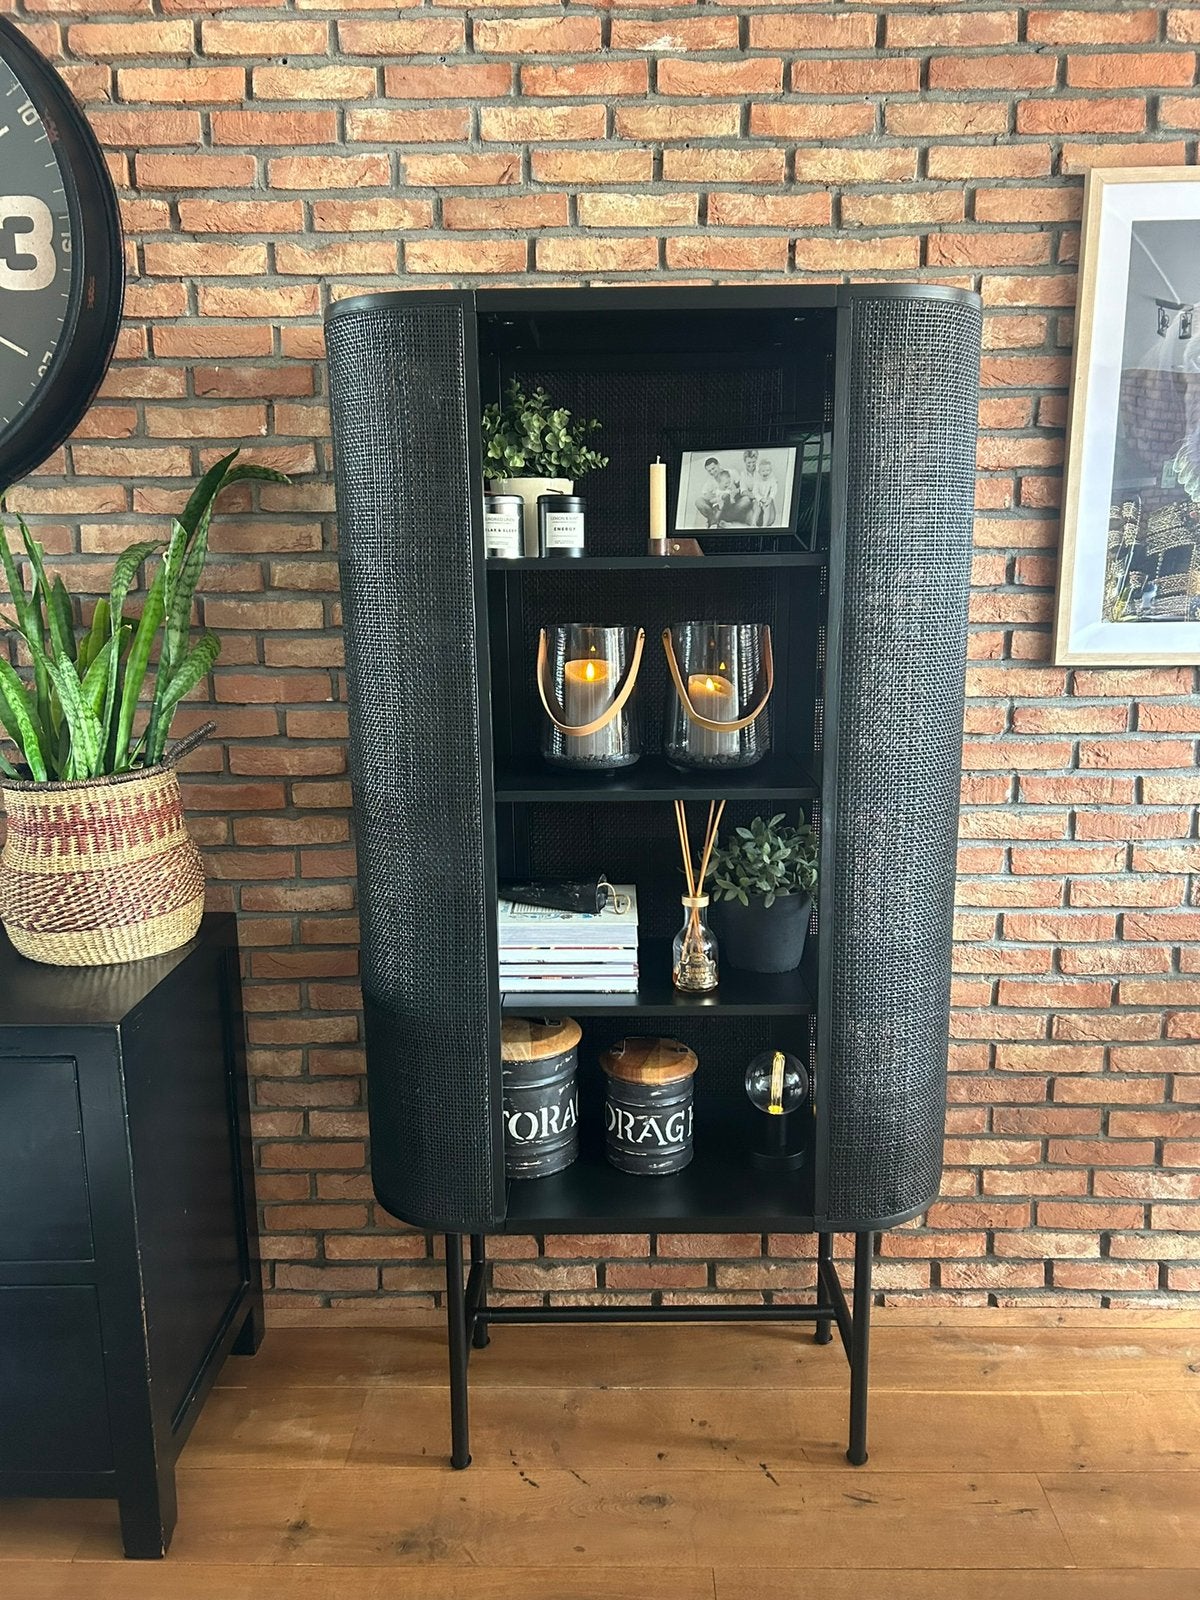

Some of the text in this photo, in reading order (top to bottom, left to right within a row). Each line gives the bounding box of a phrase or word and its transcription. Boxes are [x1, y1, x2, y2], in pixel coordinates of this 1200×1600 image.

[17, 100, 41, 126] 10
[0, 195, 56, 291] 3
[503, 1090, 579, 1141] ORA
